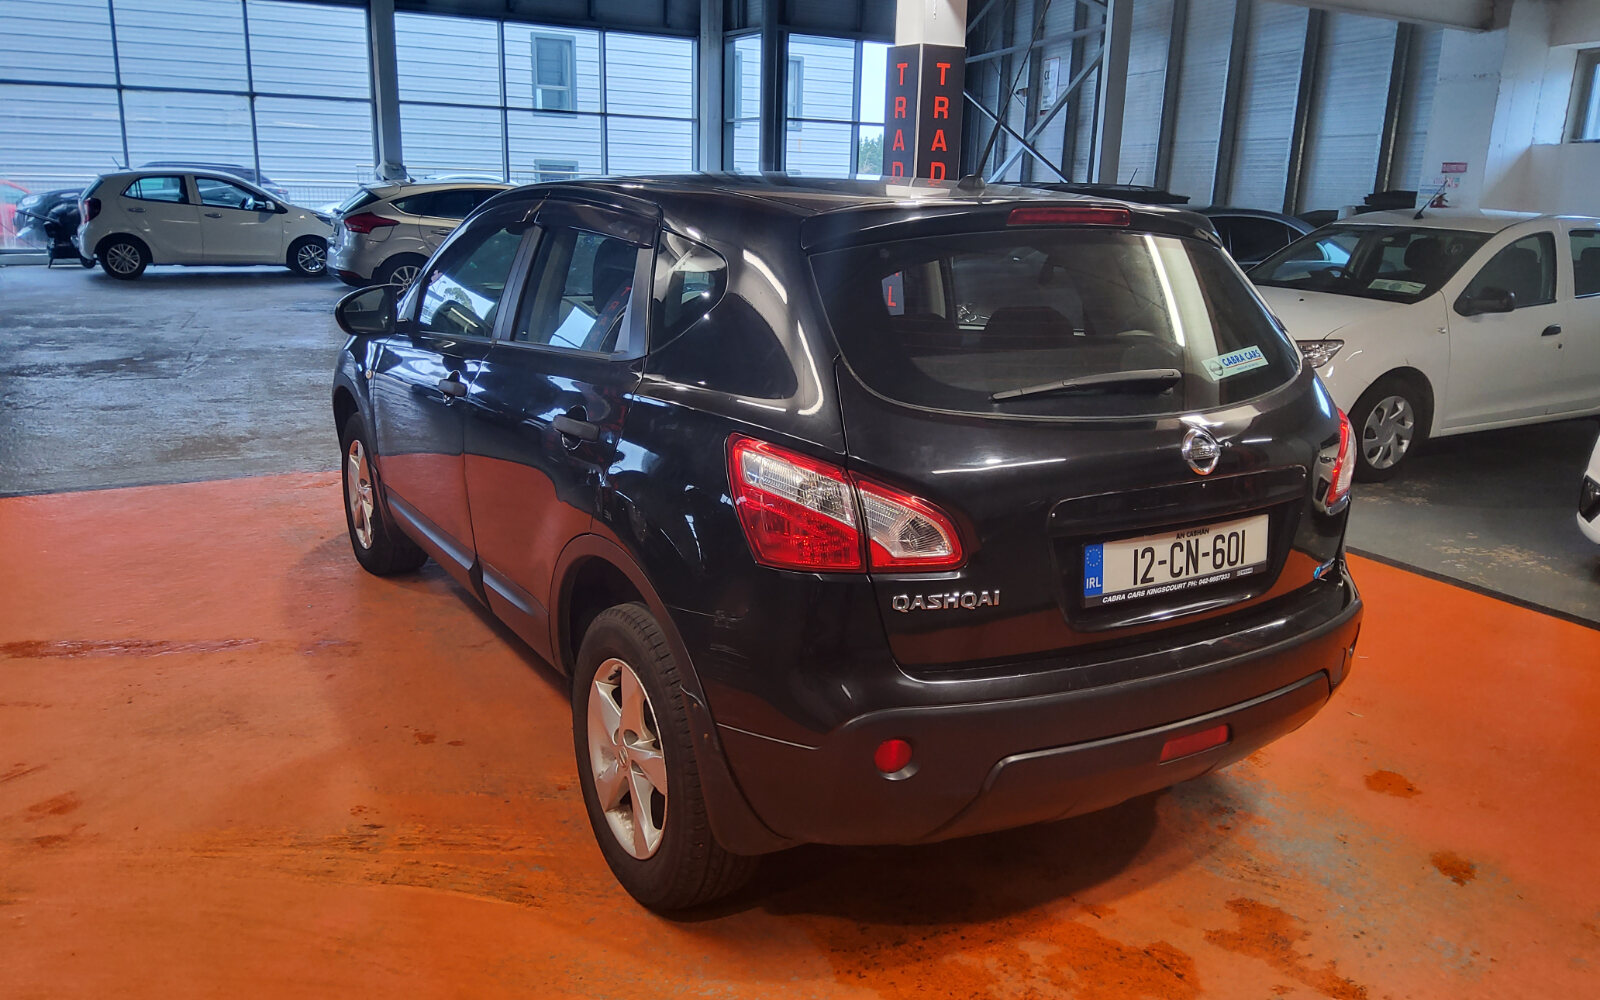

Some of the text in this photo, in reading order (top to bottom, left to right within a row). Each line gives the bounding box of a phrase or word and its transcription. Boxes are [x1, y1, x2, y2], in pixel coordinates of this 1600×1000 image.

[930, 62, 950, 180] TRAD
[1221, 354, 1245, 367] CABRA
[1244, 349, 1261, 360] CARS
[1133, 529, 1246, 586] 12-CN-601
[1086, 576, 1102, 589] IRL
[1102, 594, 1126, 603] CABRA
[1127, 590, 1146, 599] CARS
[1146, 582, 1187, 596] KINGSCOURT
[892, 590, 1000, 613] QASHQAI
